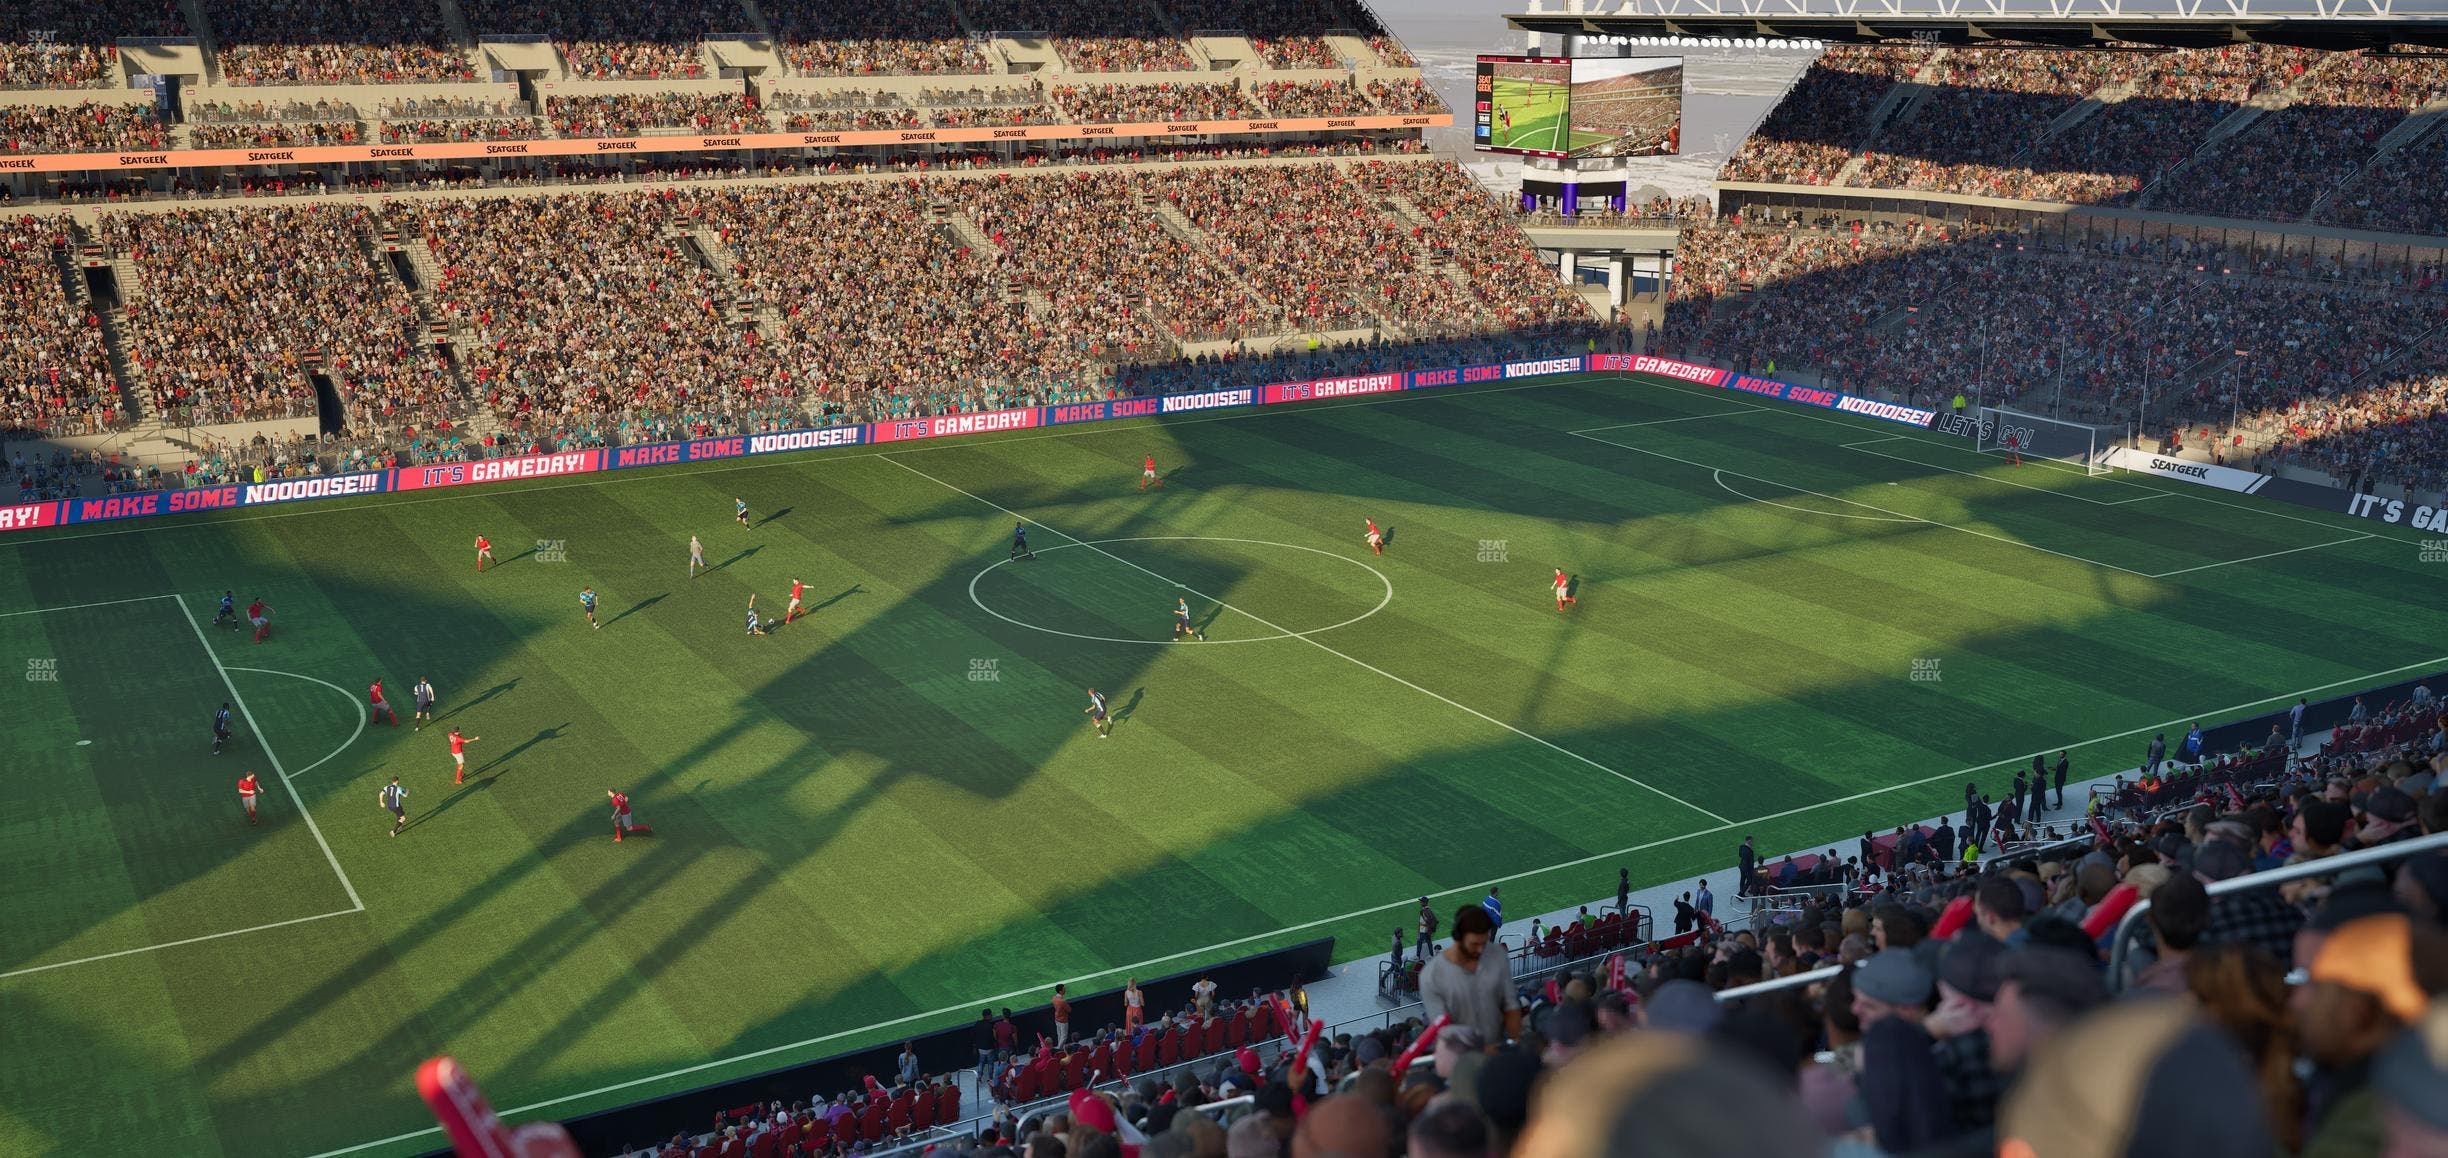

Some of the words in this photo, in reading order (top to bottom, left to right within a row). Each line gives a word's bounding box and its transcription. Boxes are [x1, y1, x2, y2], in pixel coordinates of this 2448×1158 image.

[1249, 121, 1278, 129] SEATGEEK
[1327, 119, 1356, 127] SEATGEEK
[1403, 117, 1430, 125] SEATGEEK
[993, 129, 1027, 137] SEATGEEK
[1082, 127, 1114, 135] SEATGEEK
[1167, 124, 1198, 132] SEATGEEK
[804, 135, 840, 144] SEATGEEK
[901, 132, 936, 140] SEATGEEK
[597, 141, 637, 150] SEATGEEK
[703, 138, 741, 147] SEATGEEK
[370, 148, 413, 157] SEATGEEK
[487, 144, 528, 154] SEATGEEK
[120, 155, 168, 165] SEATGEEK
[248, 152, 294, 161] SEATGEEK
[1414, 369, 1458, 387] MAKE
[1463, 365, 1502, 383] SOME
[1505, 357, 1580, 378] NOOOOISE!!!
[1603, 354, 1632, 370] IT'S
[1633, 356, 1716, 382] GAMEDAY!
[1282, 384, 1311, 400] IT'S
[1314, 376, 1393, 397] GAMEDAY!
[1734, 375, 1785, 398] MAKE
[1787, 386, 1838, 407] SOME
[1054, 403, 1106, 423] MAKE
[1111, 398, 1158, 419] SOME
[1163, 389, 1252, 412] NOOOOISE!!!
[894, 420, 929, 439] IT'S
[934, 411, 1028, 435] GAMEDAY!
[618, 441, 680, 466] MAKE
[689, 437, 745, 459] SOME
[750, 427, 859, 453] NOOOOISE!!!
[423, 465, 465, 486] IT'S
[472, 453, 586, 481] GAMEDAY!
[2150, 458, 2210, 480] SEATGEEK
[81, 495, 157, 520] MAKE
[169, 487, 239, 512] SOME
[245, 474, 379, 503] NOOOOISE!!!
[2347, 493, 2405, 523] IT'S
[2411, 505, 2448, 534] GA
